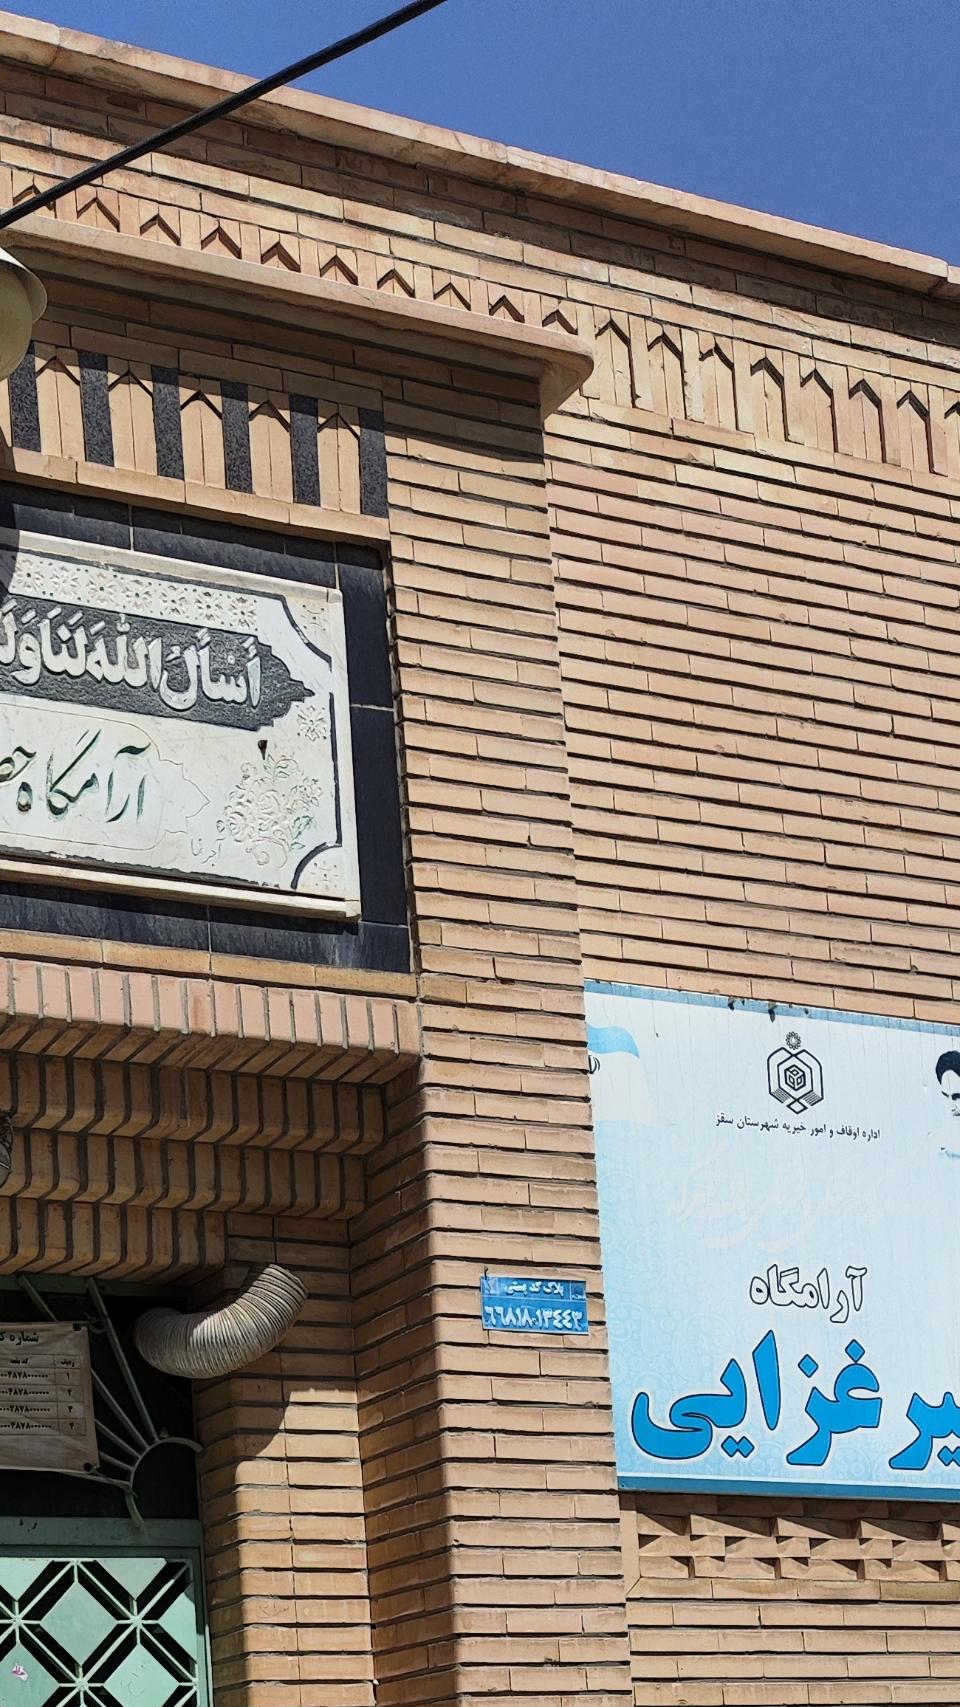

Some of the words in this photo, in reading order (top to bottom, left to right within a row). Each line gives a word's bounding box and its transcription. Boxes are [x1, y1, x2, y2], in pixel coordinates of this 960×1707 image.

[16, 729, 151, 822] آرامگاه
[715, 1112, 734, 1127] سقز
[736, 1115, 779, 1132] شهرستان
[782, 1123, 806, 1135] خیریه
[809, 1124, 827, 1137] امور
[829, 1129, 834, 1138] و
[836, 1125, 860, 1140] اوقاف
[861, 1129, 881, 1141] اداره
[749, 1263, 868, 1324] آرامگاه
[9, 1327, 39, 1344] شماره
[631, 1330, 883, 1466] غزایی
